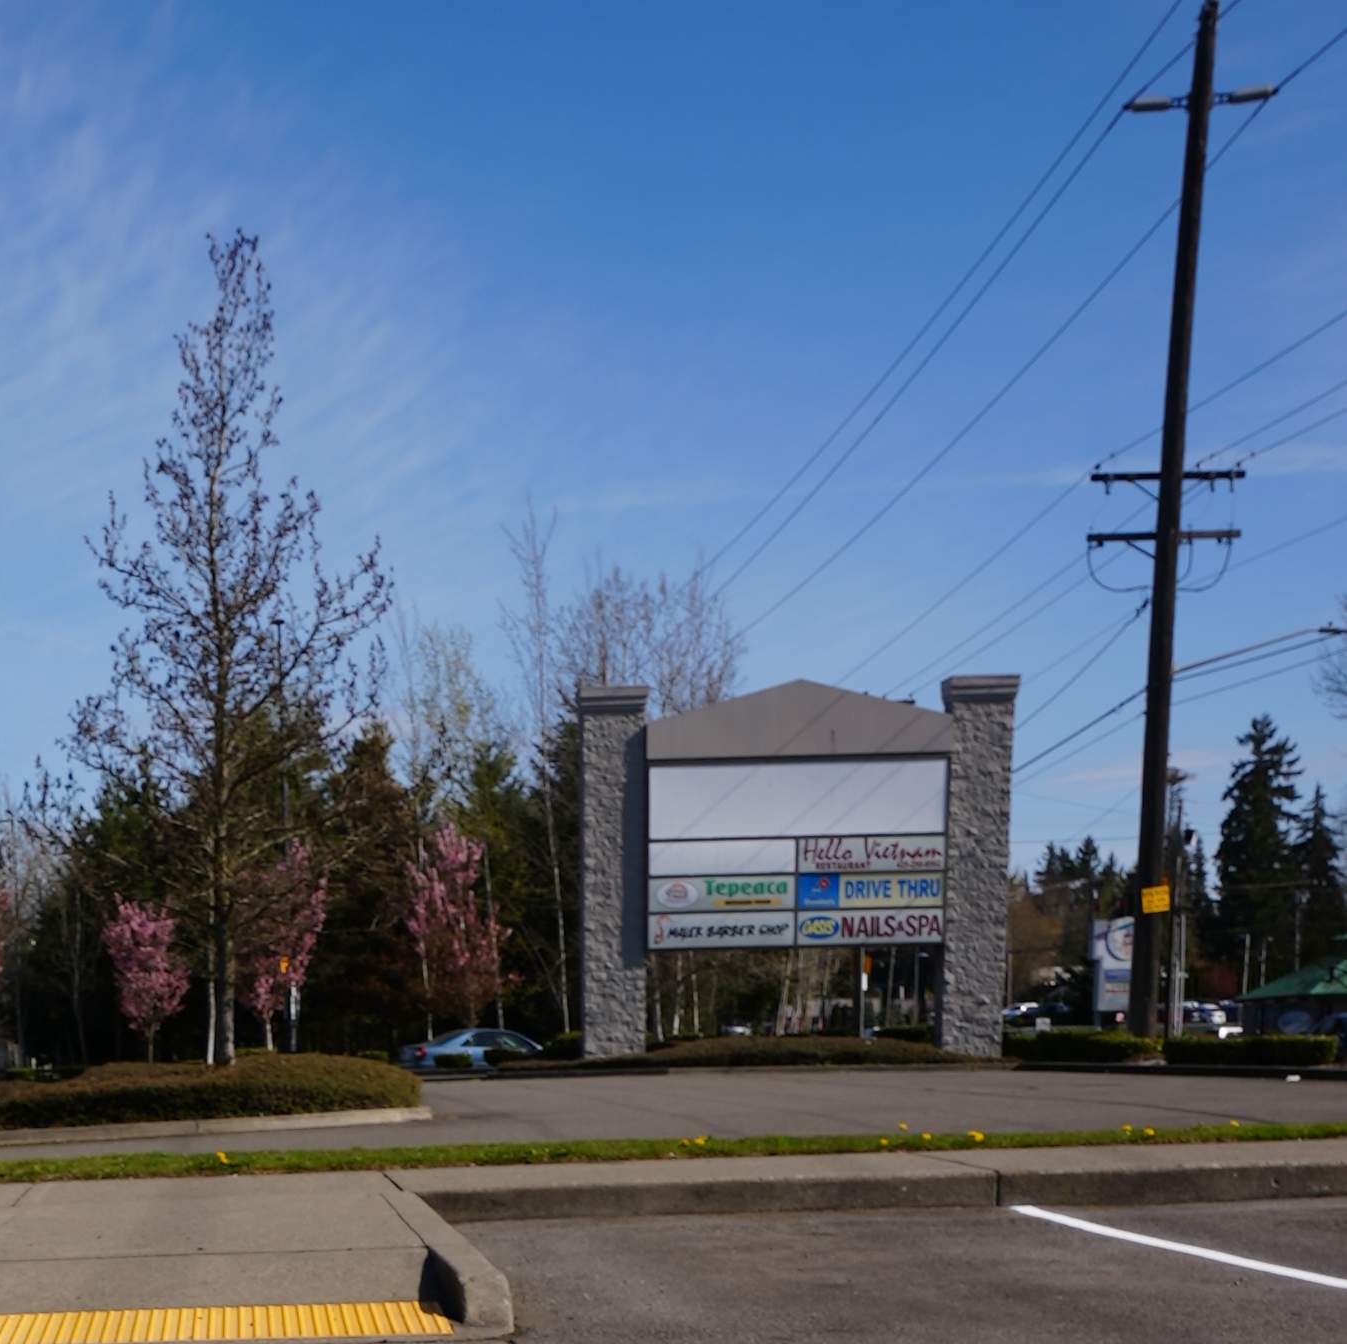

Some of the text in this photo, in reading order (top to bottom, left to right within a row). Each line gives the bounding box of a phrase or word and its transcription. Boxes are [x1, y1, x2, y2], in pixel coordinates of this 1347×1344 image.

[803, 837, 943, 861] Hello Vietnam
[703, 880, 788, 897] Tepeaca
[845, 878, 941, 898] DRIVE THRU
[706, 924, 755, 938] BARBER
[758, 923, 790, 936] SHOP
